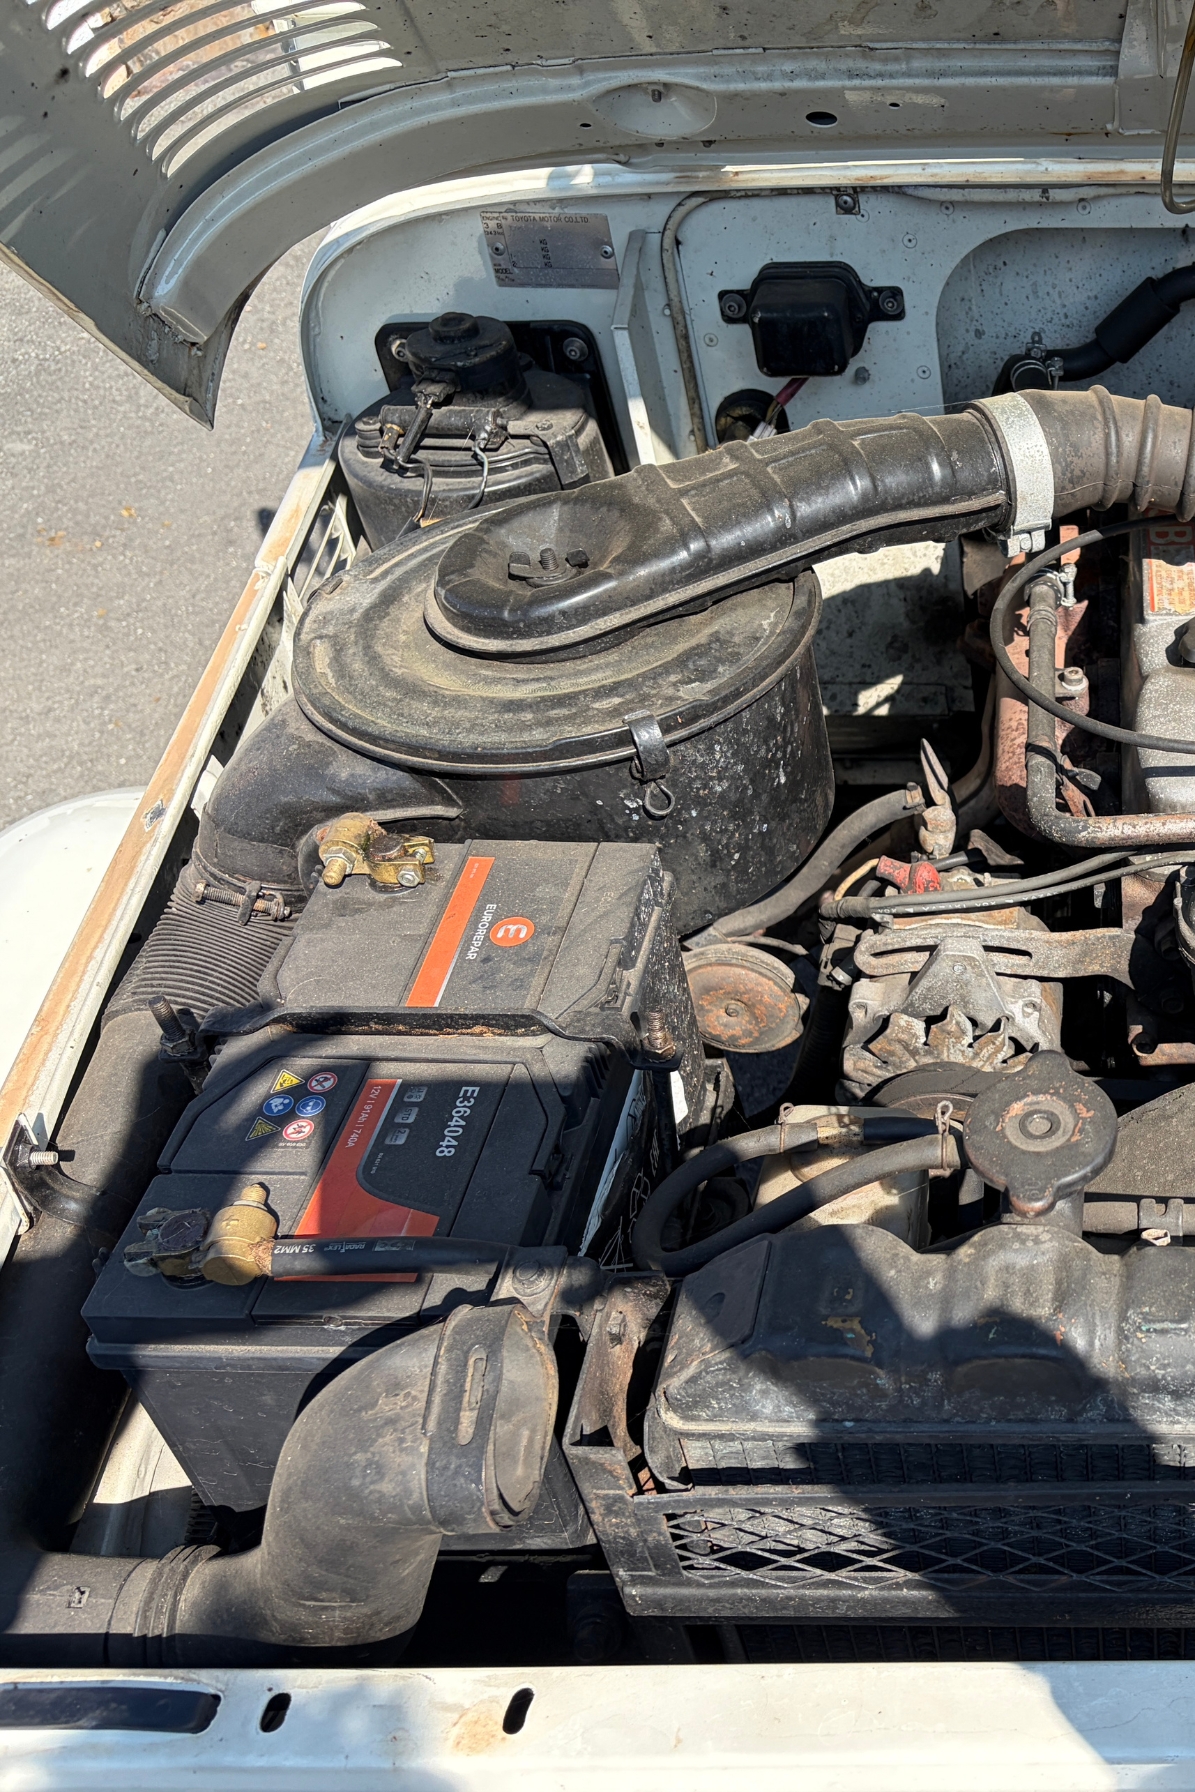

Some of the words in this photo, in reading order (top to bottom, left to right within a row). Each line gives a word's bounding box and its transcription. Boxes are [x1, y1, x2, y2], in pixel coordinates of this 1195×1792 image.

[539, 215, 562, 223] MOTOR
[465, 904, 497, 960] EUROREPAR
[369, 1086, 381, 1099] 12V
[357, 1105, 373, 1123] 91Ah
[401, 1109, 413, 1121] STD
[435, 1086, 479, 1157] E364048
[345, 1130, 361, 1147] 740A
[274, 1244, 302, 1254] MM2
[302, 1244, 316, 1253] 35
